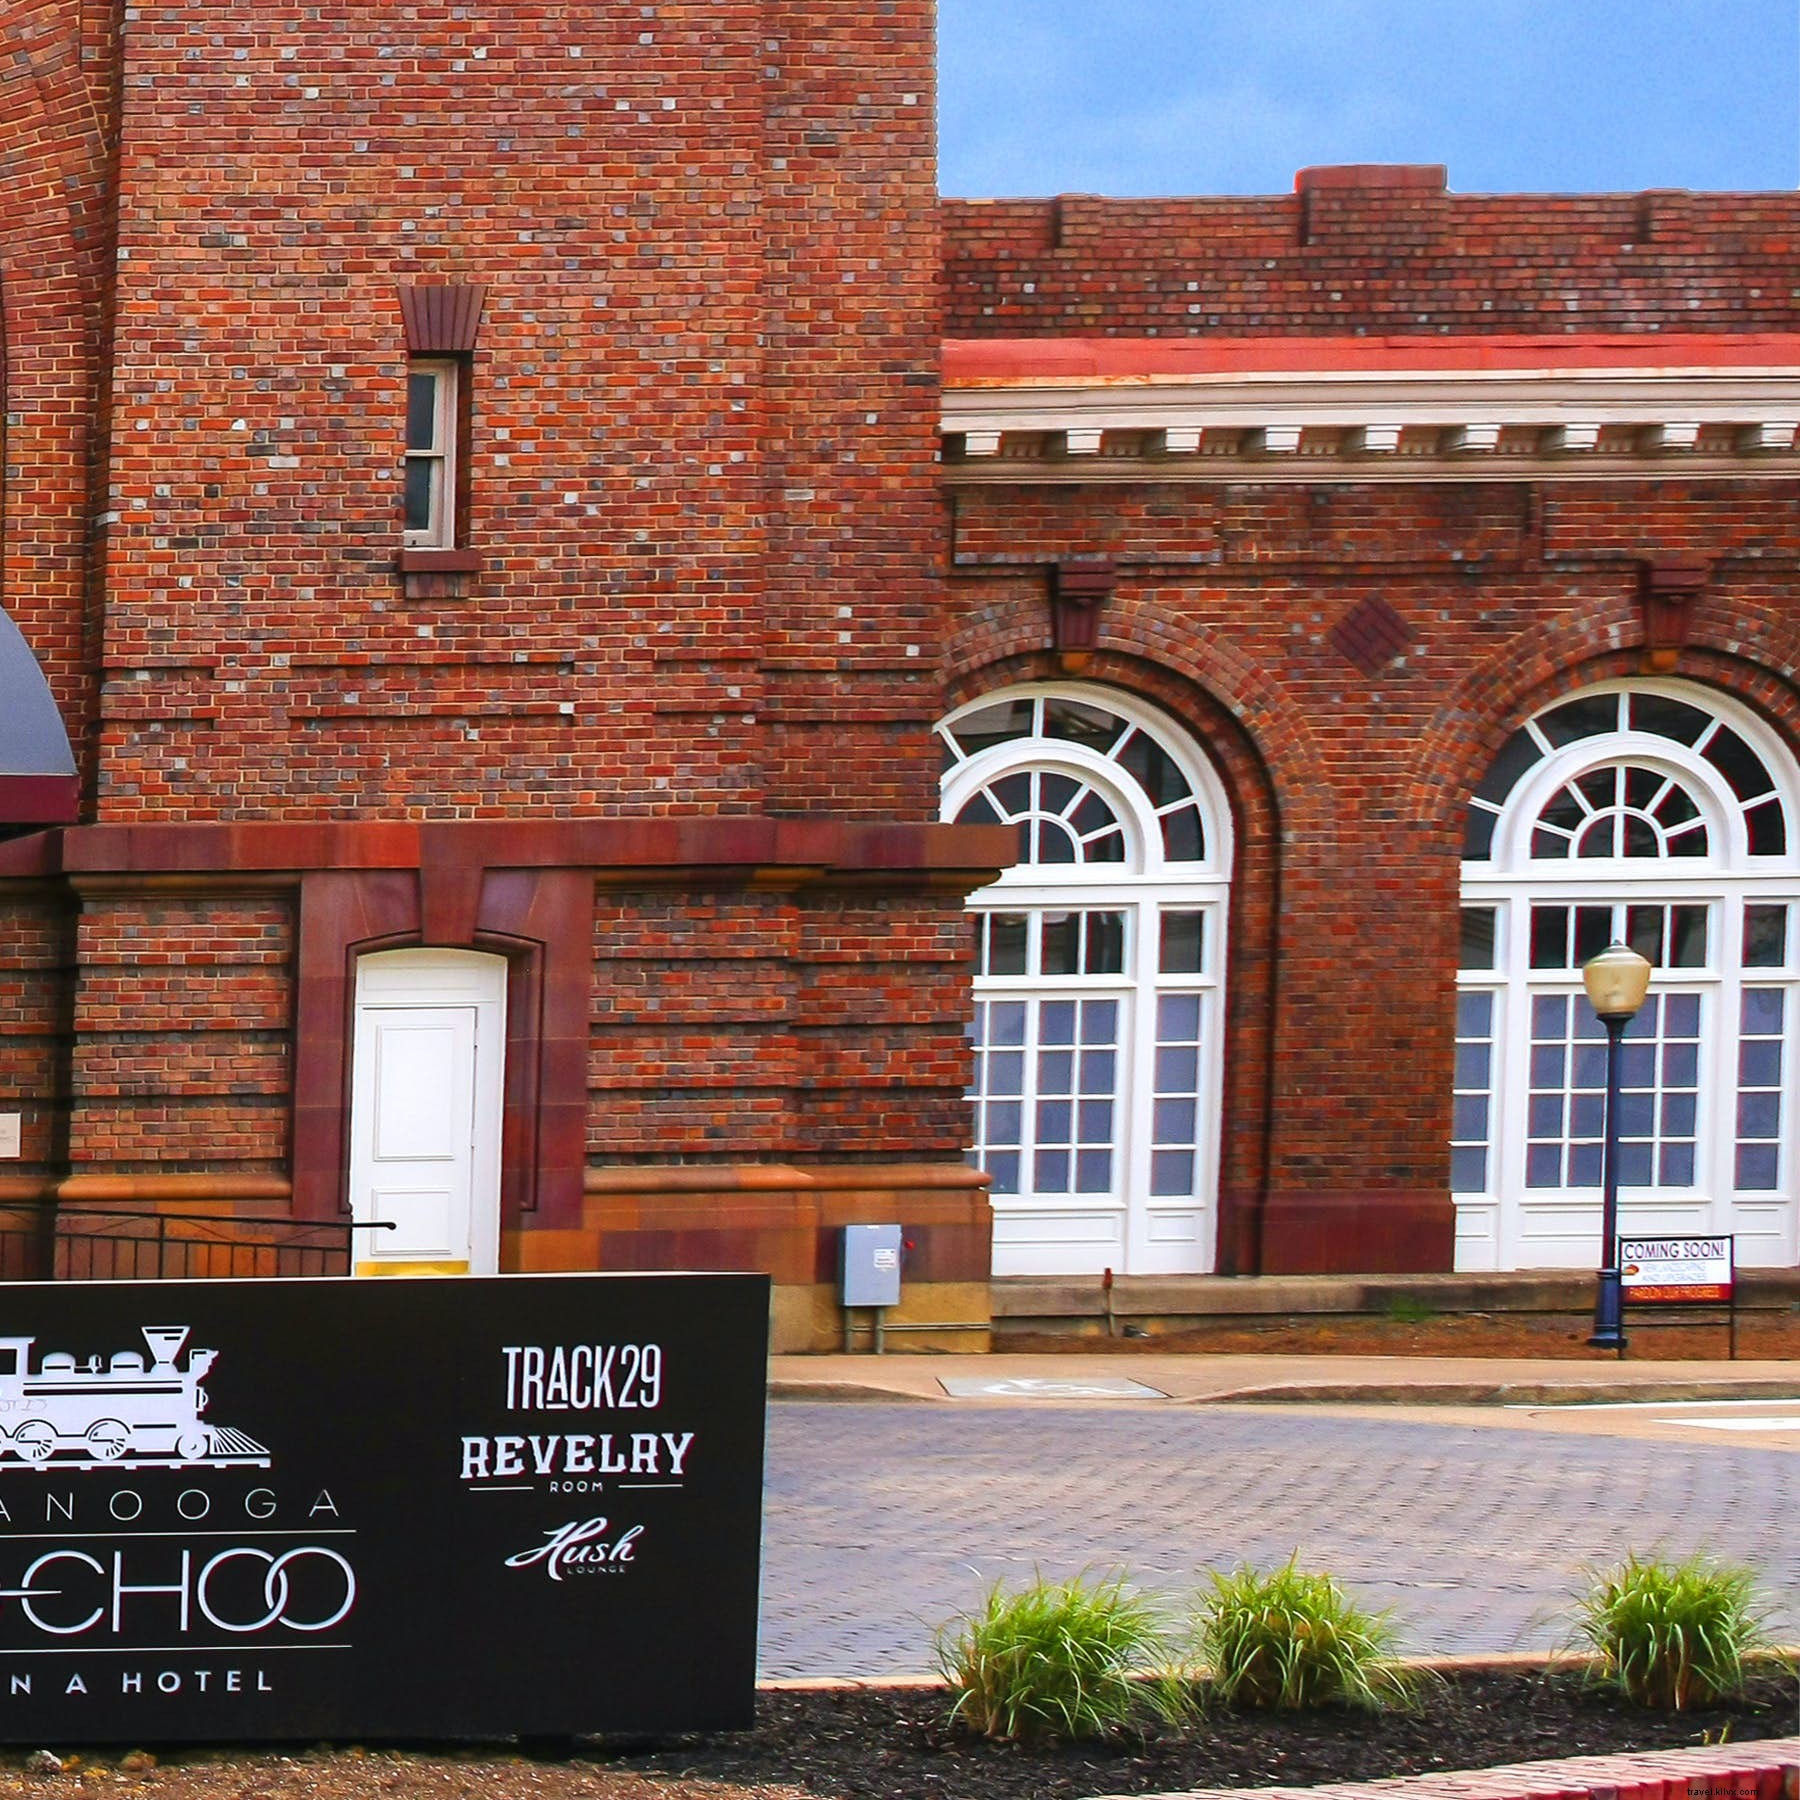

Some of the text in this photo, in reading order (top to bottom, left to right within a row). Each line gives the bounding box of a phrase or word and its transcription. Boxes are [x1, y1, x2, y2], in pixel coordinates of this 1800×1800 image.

[1624, 1241, 1724, 1259] COMING SOON!
[502, 1344, 662, 1409] TRACK29
[460, 1433, 694, 1479] REVELRY
[550, 1481, 603, 1493] ROOM
[504, 1517, 645, 1581] Hush
[566, 1565, 626, 1575] LOUNGE
[65, 1673, 88, 1695] A
[122, 1670, 273, 1694] HOTEL
